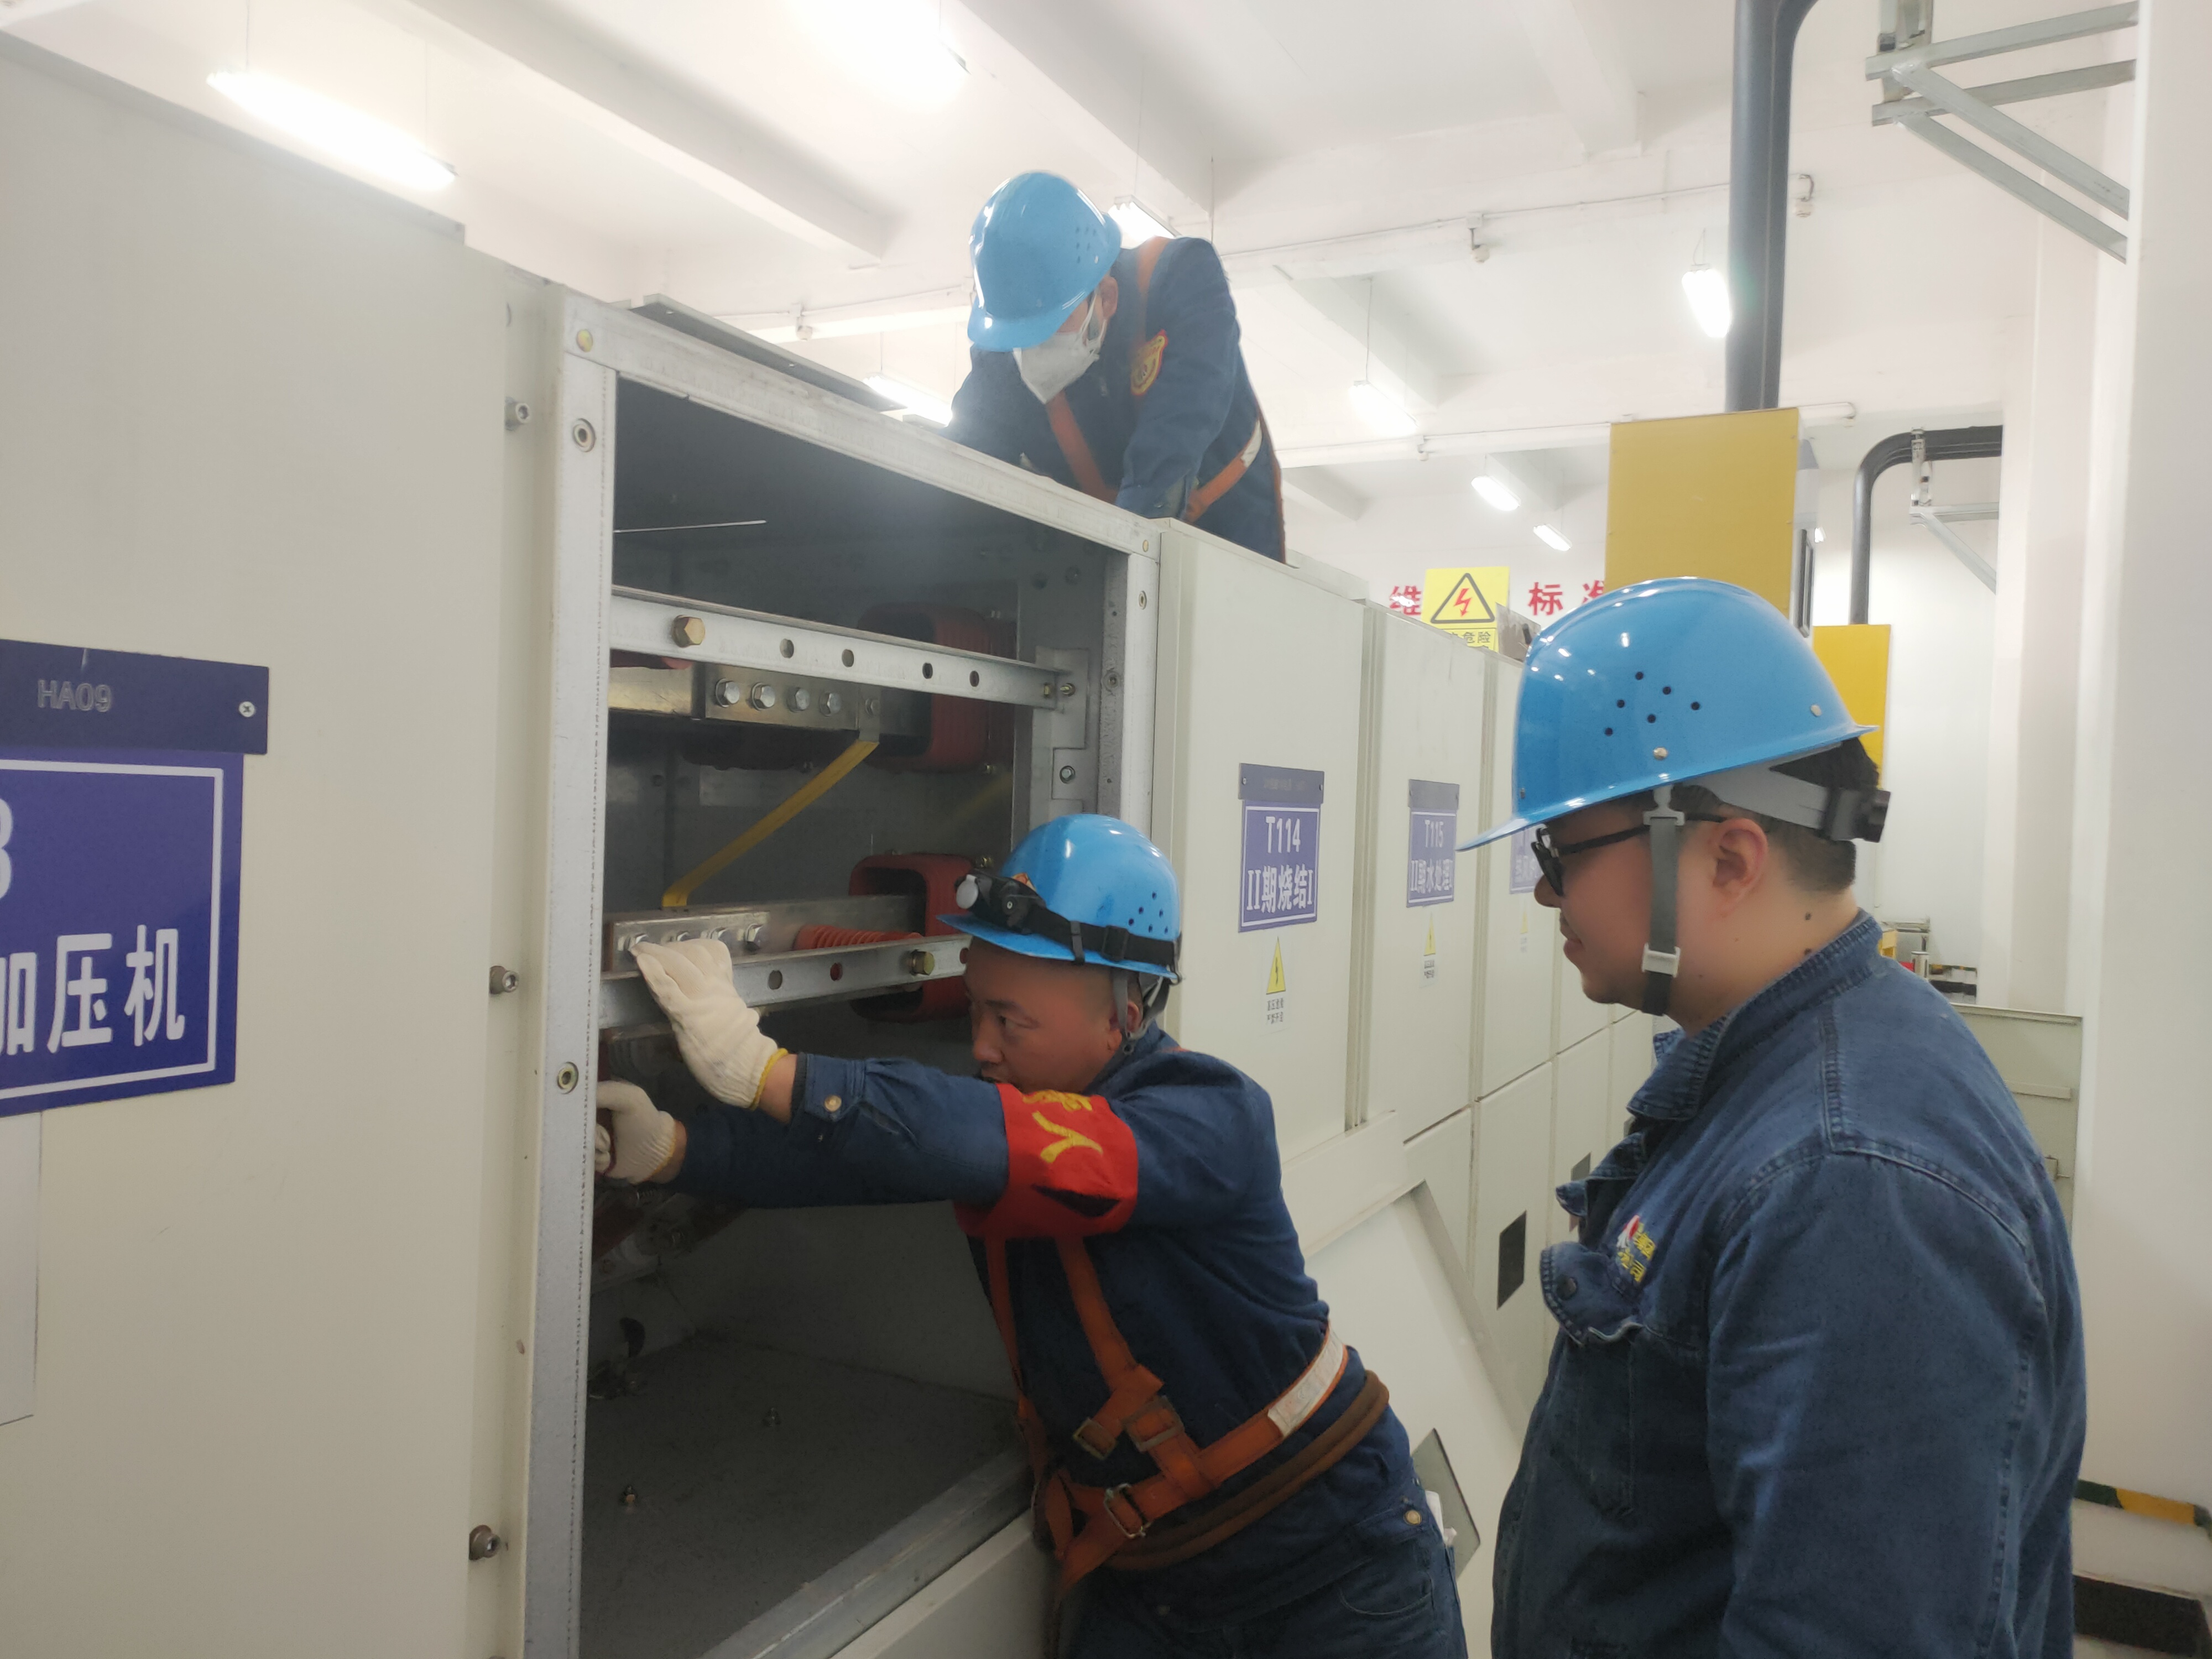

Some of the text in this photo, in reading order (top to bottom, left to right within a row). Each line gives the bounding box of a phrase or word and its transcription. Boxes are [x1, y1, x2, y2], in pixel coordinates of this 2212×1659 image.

[1452, 631, 1491, 644] 危险
[37, 679, 113, 713] HA09
[1265, 816, 1301, 853] T114
